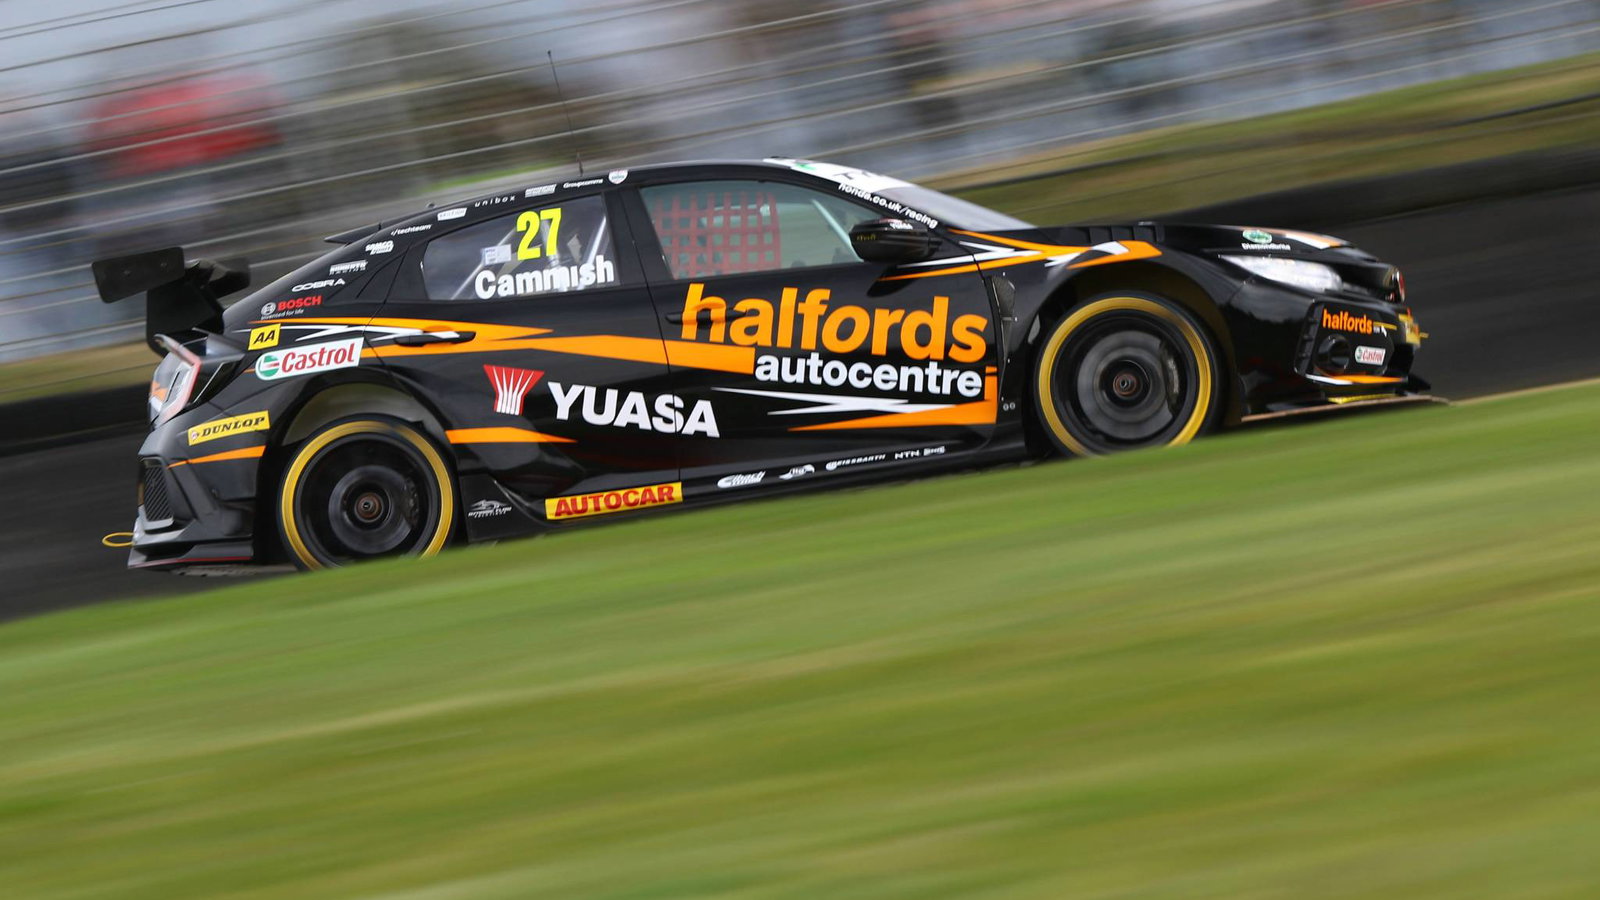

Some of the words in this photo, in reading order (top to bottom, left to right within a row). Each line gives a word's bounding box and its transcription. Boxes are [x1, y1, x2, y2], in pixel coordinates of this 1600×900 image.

[475, 195, 516, 208] unibox
[838, 182, 939, 229] honda.co.uk/racing
[515, 206, 562, 262] 27
[292, 278, 346, 292] COBRA
[474, 254, 615, 300] Cammish
[277, 295, 323, 312] BOSCH
[681, 283, 988, 364] halfords
[1322, 308, 1373, 335] halfords
[253, 329, 276, 345] AA
[281, 343, 355, 373] Castrol
[755, 352, 983, 397] autocentre
[547, 381, 721, 438] YUASA
[202, 416, 265, 437] DUNLOP
[894, 449, 920, 460] NTN
[554, 485, 675, 518] AUTOCAR
